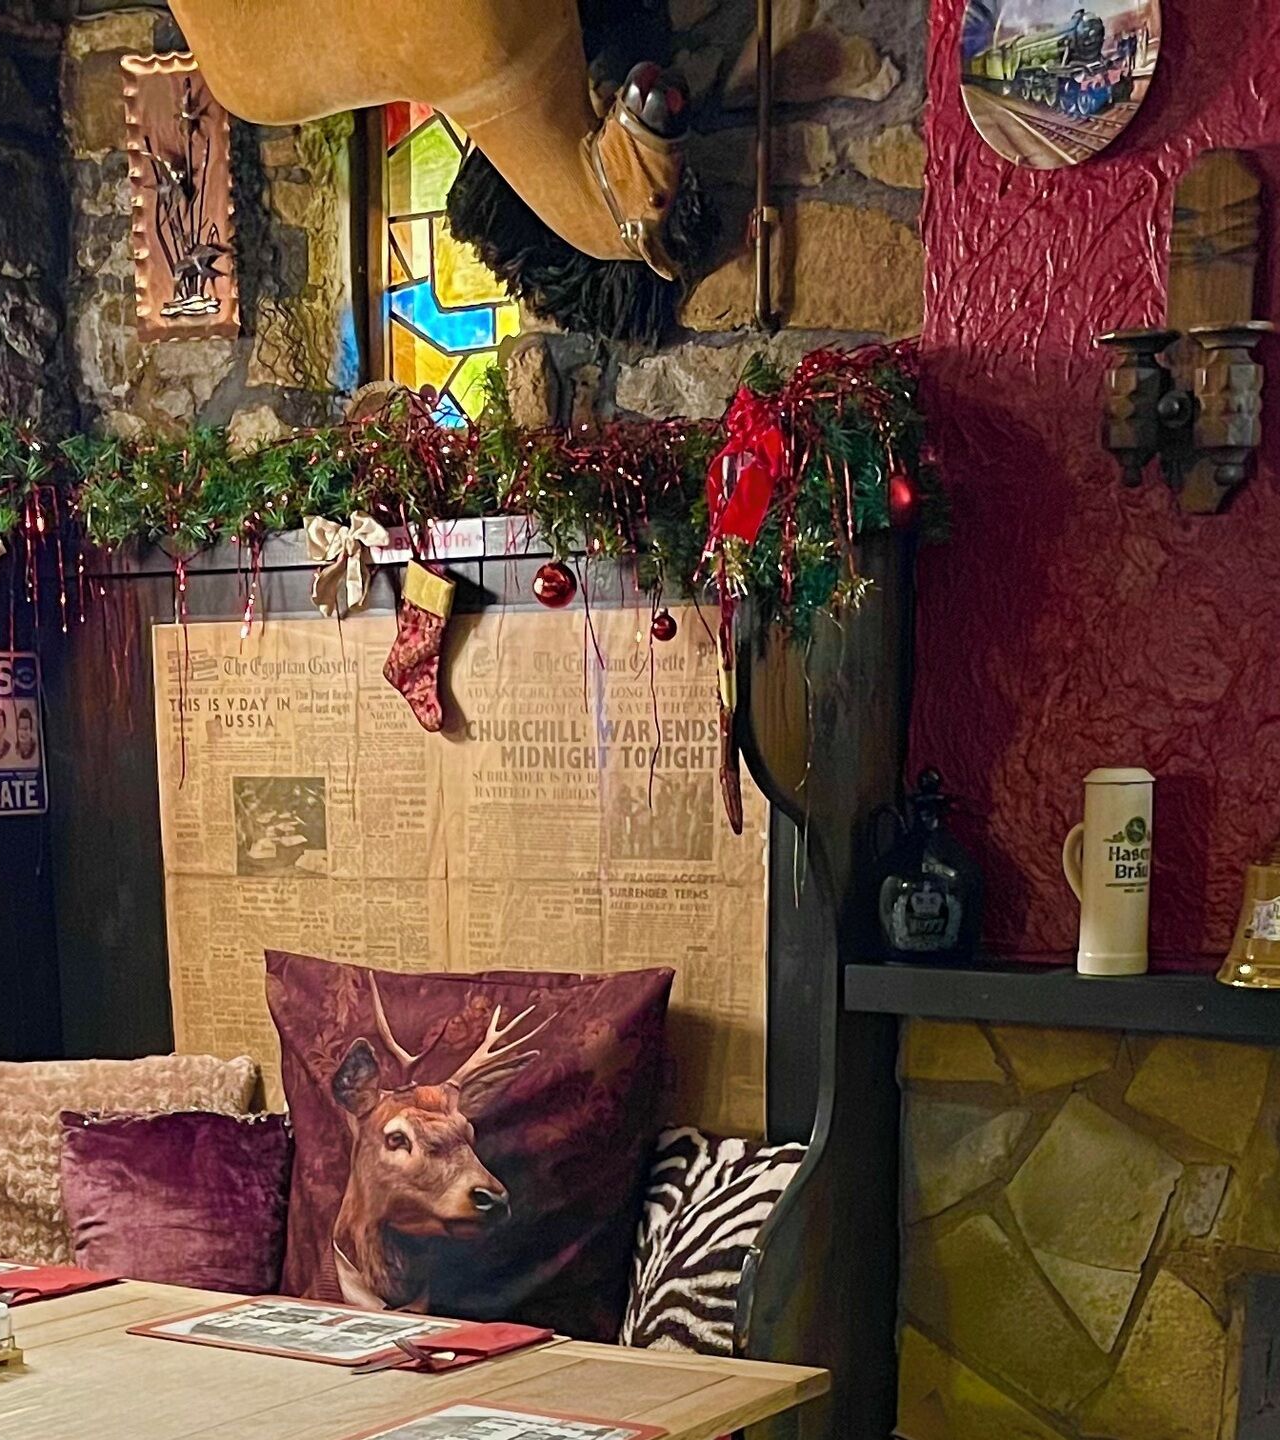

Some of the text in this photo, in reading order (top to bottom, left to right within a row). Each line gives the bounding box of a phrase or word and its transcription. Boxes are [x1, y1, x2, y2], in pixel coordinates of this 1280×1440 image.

[223, 655, 248, 678] The
[168, 698, 200, 713] THIS
[208, 698, 220, 712] IS
[277, 696, 291, 711] IN
[598, 720, 651, 742] WAR
[661, 719, 718, 742] ENDS
[501, 746, 719, 769] MIDNIGHT TONIGHT
[609, 887, 710, 900] SURRENDER TERMS
